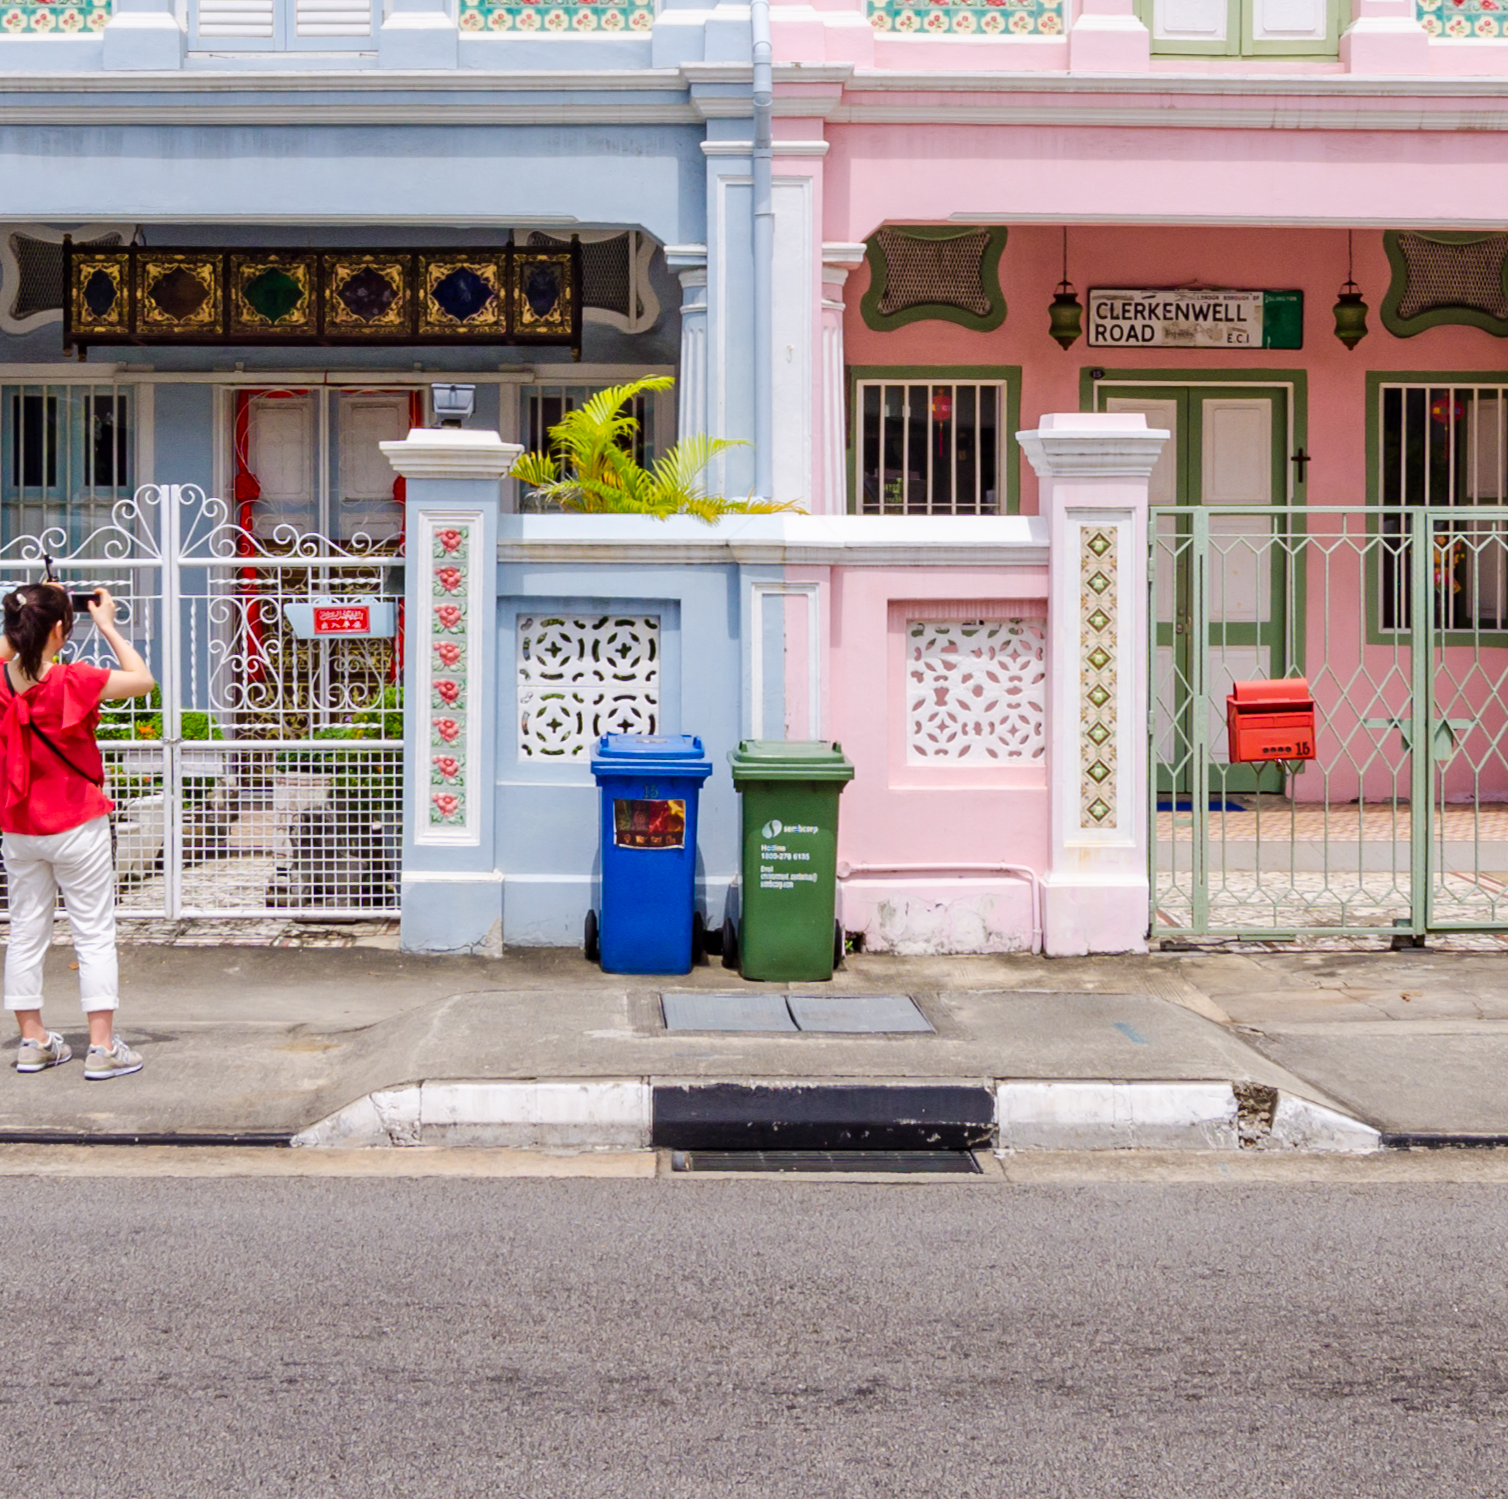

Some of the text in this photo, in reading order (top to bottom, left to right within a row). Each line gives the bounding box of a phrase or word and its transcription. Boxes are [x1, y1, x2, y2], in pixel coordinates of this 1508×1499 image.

[1095, 302, 1248, 323] CLERKENWELL
[1095, 323, 1155, 343] ROAD
[1295, 741, 1311, 756] 15
[643, 784, 659, 799] 15
[783, 824, 819, 835] sembcorp
